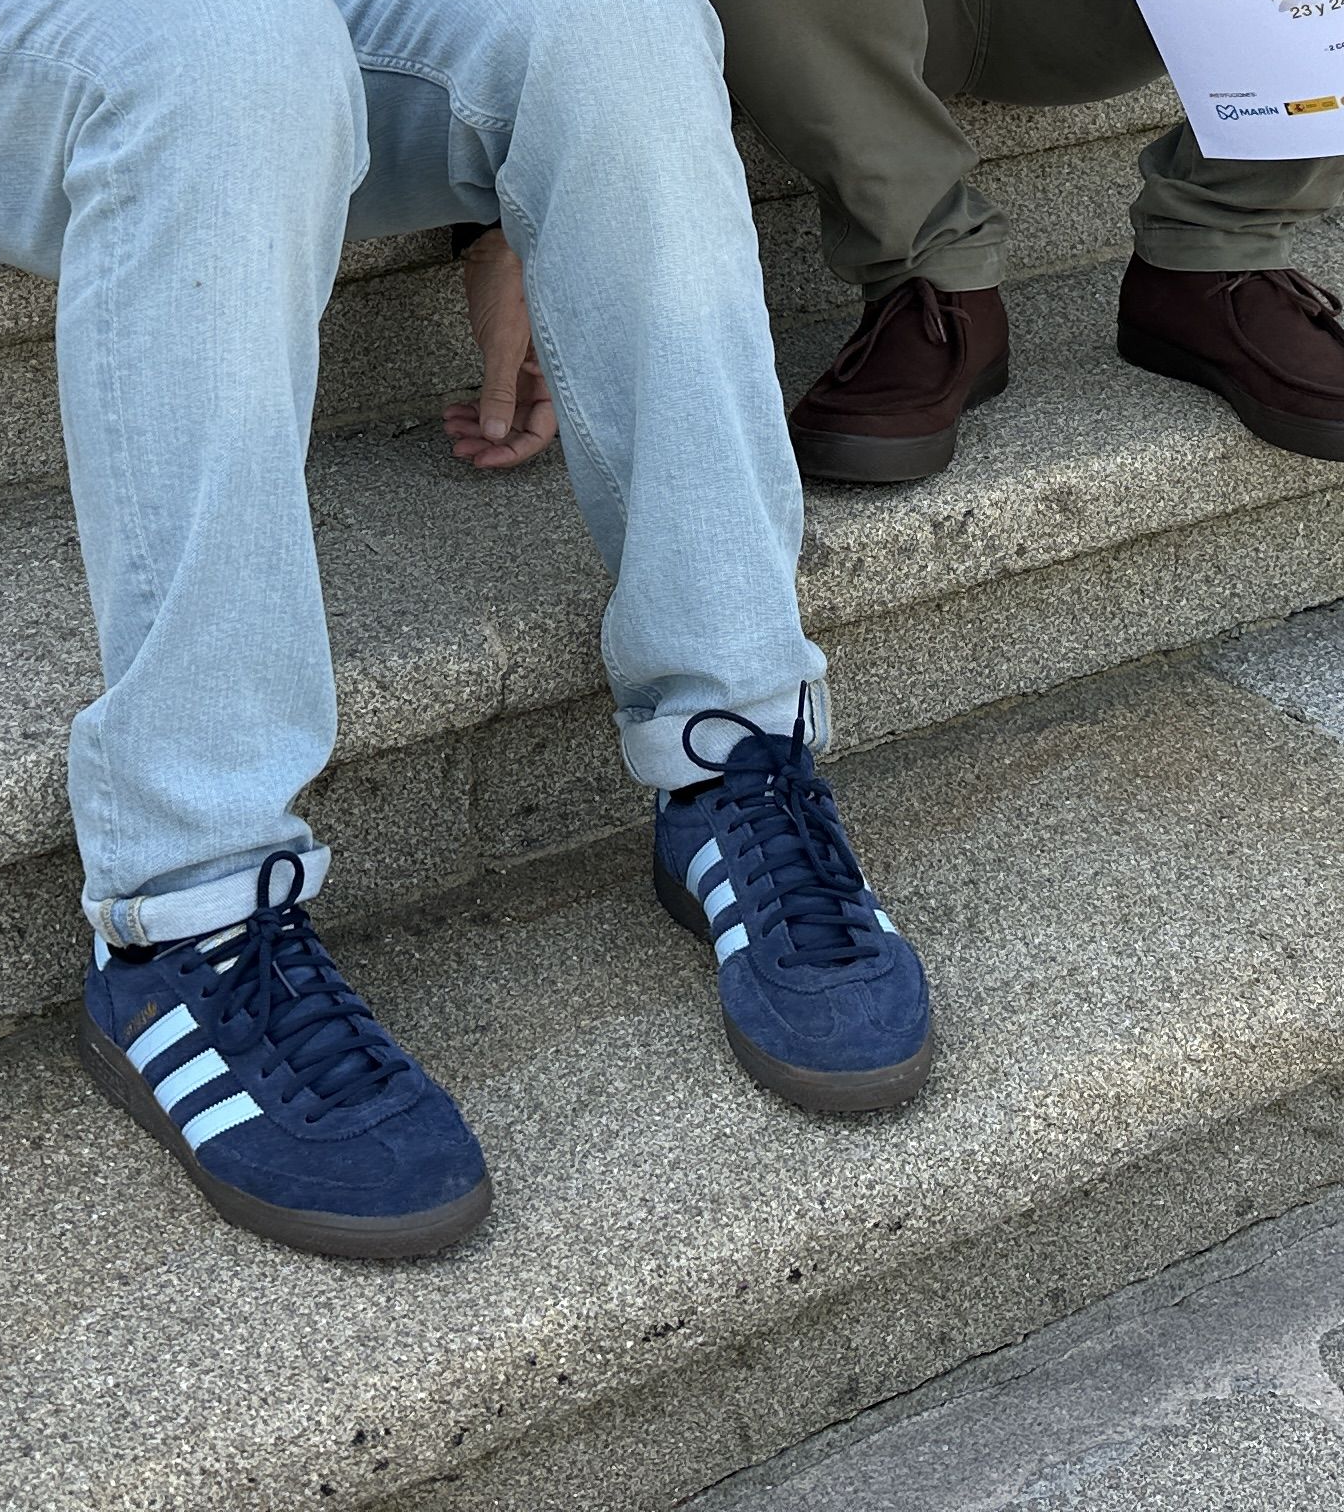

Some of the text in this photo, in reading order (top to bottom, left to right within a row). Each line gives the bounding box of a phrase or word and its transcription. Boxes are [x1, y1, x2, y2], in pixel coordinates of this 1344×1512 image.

[1289, 4, 1313, 20] 23
[1315, 3, 1325, 16] y
[1239, 106, 1280, 116] MARÍN
